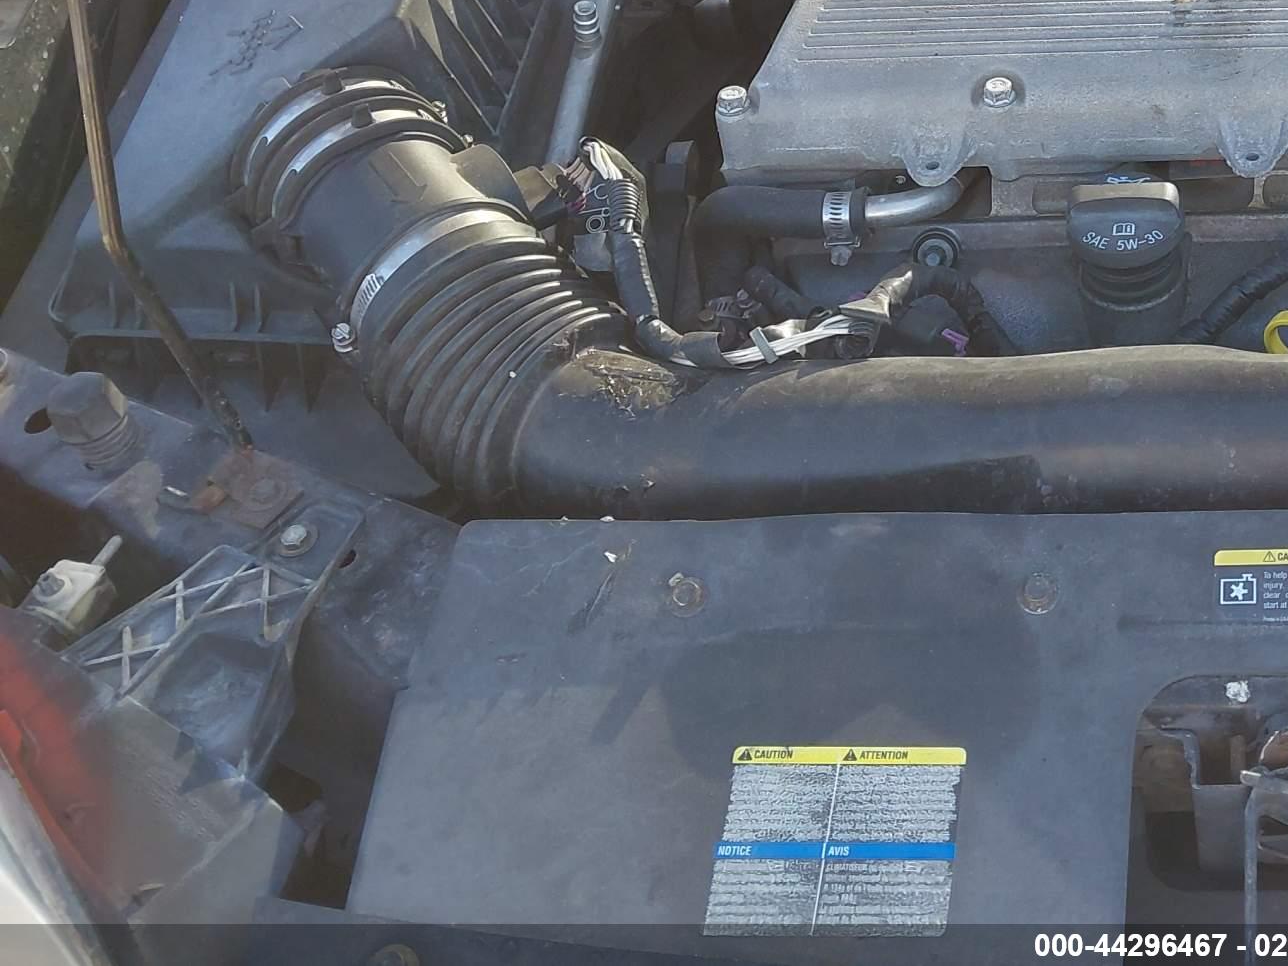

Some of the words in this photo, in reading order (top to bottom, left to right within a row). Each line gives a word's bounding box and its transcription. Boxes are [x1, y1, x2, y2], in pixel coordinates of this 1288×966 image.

[1082, 231, 1110, 249] SAE
[1116, 230, 1164, 251] 5W-30
[1273, 571, 1288, 580] help
[754, 749, 793, 759] CAUTION
[859, 750, 908, 760] ATTENTION
[717, 845, 752, 856] NOTICE
[828, 845, 850, 856] AVIS
